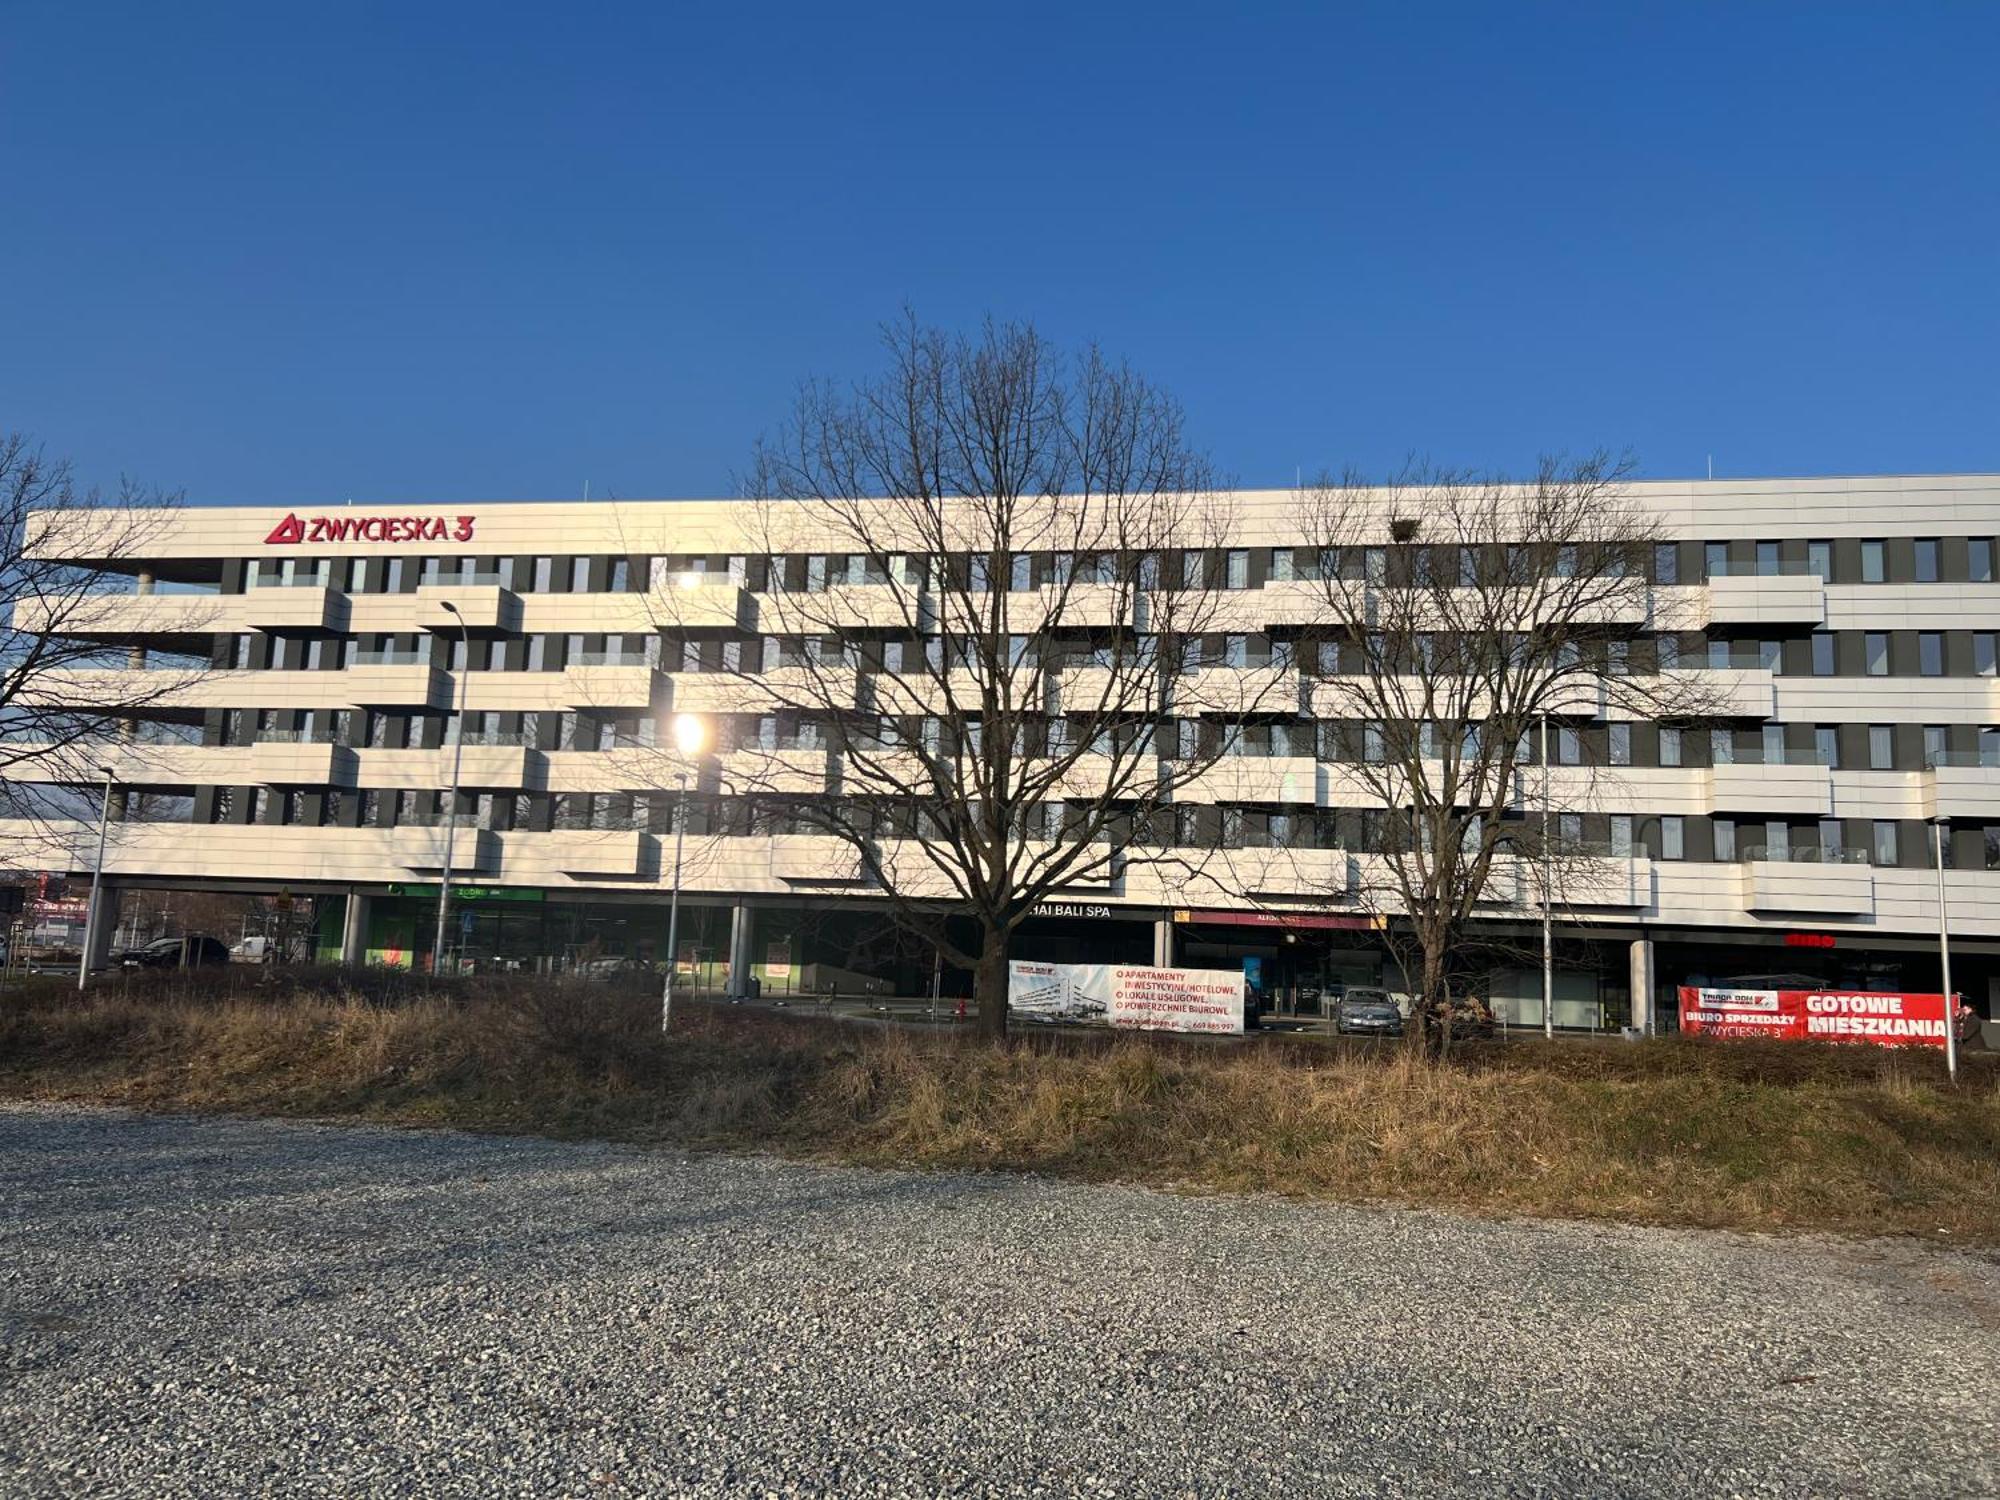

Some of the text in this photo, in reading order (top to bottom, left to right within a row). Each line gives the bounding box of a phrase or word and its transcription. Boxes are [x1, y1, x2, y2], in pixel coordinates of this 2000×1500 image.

[308, 516, 476, 543] ZWYCIĘSKA 3
[1055, 905, 1083, 917] BALI
[1086, 906, 1111, 918] SPA
[1124, 971, 1186, 981] APARTAMENTY
[1124, 991, 1155, 1001] LOKALE
[1124, 1001, 1188, 1012] POWIERZCHNIE
[1806, 995, 1904, 1014] GOTOWE
[1685, 1011, 1796, 1025] BIURO SPRZEDAŻY
[1807, 1016, 1947, 1037] MIESZKANIA
